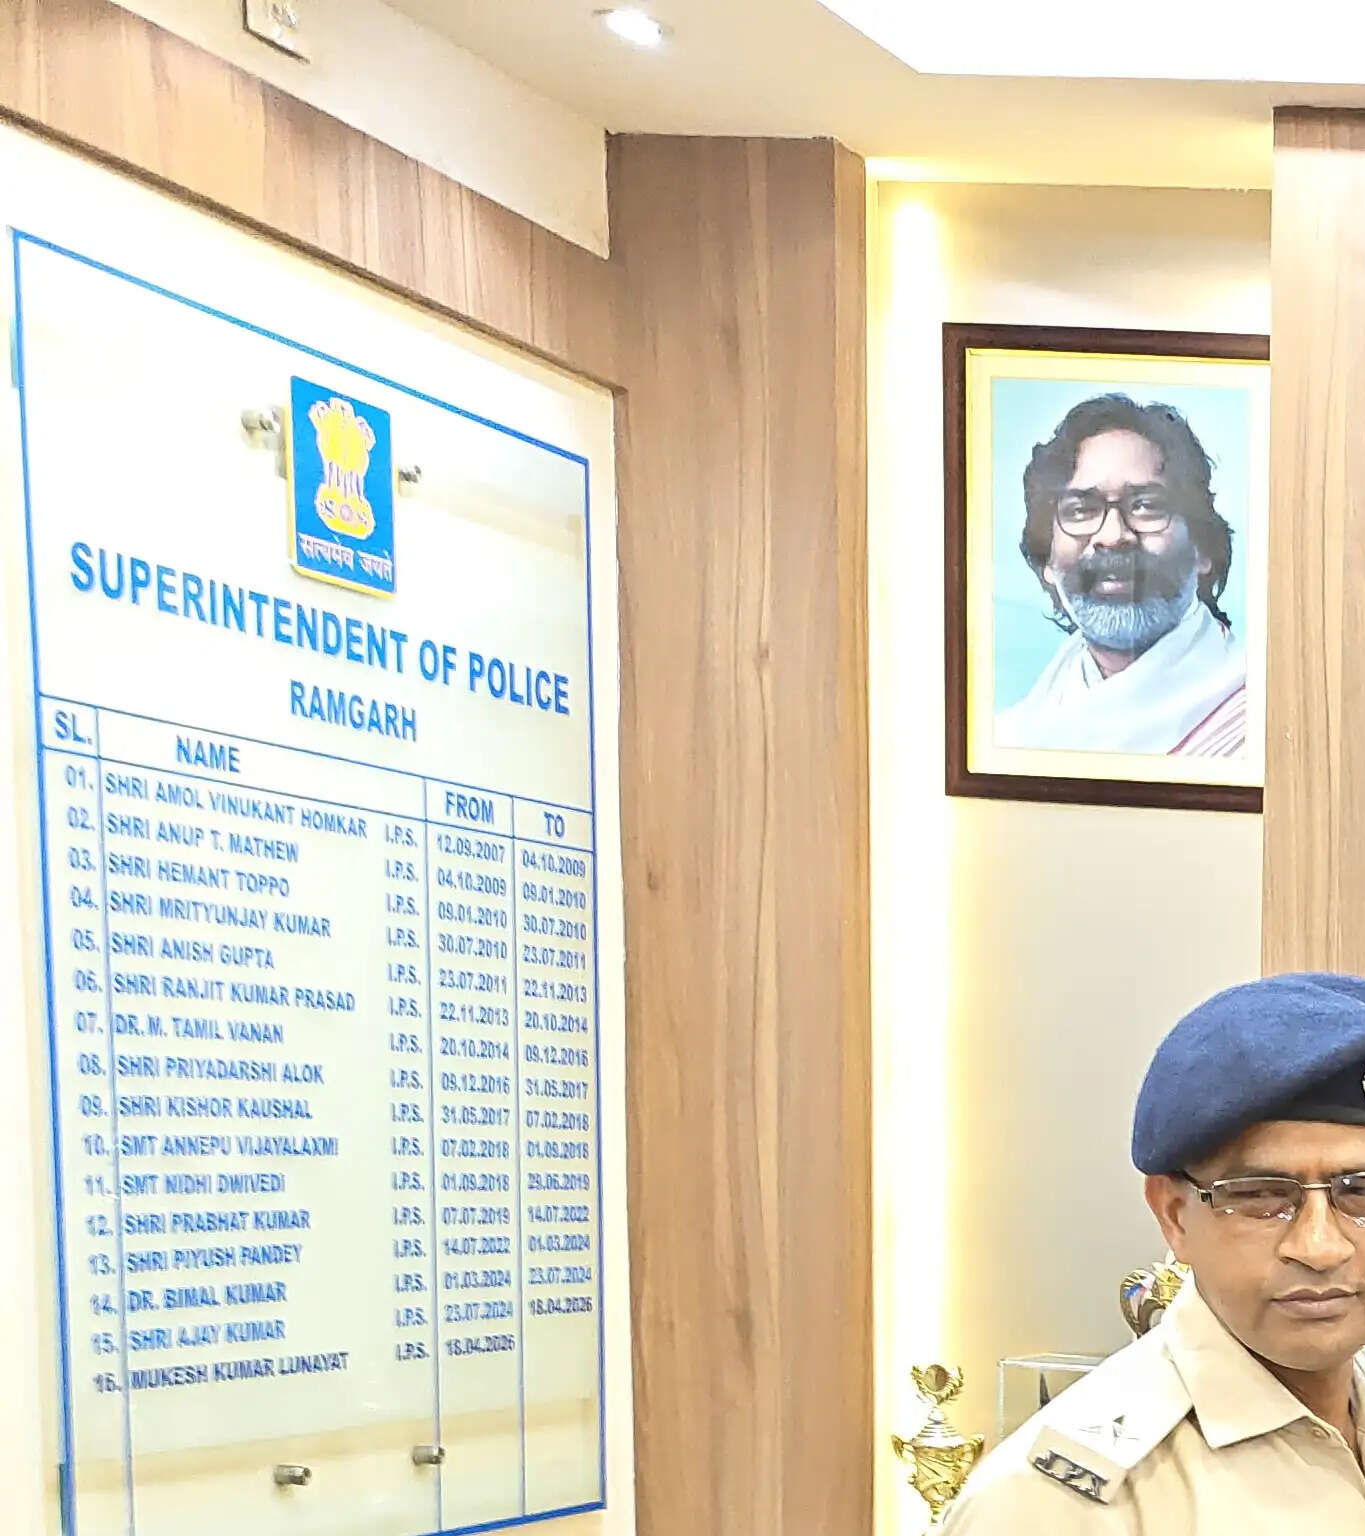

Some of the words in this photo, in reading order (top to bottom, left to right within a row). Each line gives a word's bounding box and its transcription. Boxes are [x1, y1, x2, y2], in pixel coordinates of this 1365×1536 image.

[69, 541, 408, 674] SUPERINTENDENT
[419, 640, 456, 684] OF
[469, 652, 570, 716] POLICE
[291, 678, 418, 742] RAMGARH
[54, 710, 92, 745] SL.
[175, 734, 240, 773] NAME
[445, 791, 494, 825] FROM
[544, 811, 565, 839] TO
[64, 765, 94, 790] 01.
[105, 772, 148, 800] SHRI
[155, 781, 203, 810] AMOL
[209, 790, 295, 825] VINUKANT
[301, 807, 367, 839] HOMKAR
[384, 824, 418, 848] I.P.S.
[437, 834, 505, 863] 12.09.2007
[523, 850, 585, 879] 04.10.2009
[67, 806, 95, 831] 02.
[106, 812, 149, 839] SHRI
[156, 821, 201, 848] ANUP
[229, 833, 298, 863] MATHEW
[385, 859, 419, 883] I.P.S.
[438, 868, 506, 897] 04.10.2009
[523, 882, 586, 911] 09.01.2010
[67, 847, 96, 871] 03.
[108, 851, 150, 880] SHRI
[157, 859, 229, 889] HEMANT
[236, 870, 290, 898] TOPPO
[386, 893, 420, 916] I.P.S.
[438, 902, 507, 929] 09.01.2010
[524, 914, 586, 941] 30.07.2010
[70, 886, 98, 911] 04.
[110, 891, 151, 916] SHRI
[160, 897, 268, 930] MRITYUNJAY
[274, 912, 331, 938] KUMAR
[387, 926, 420, 949] I.P.S.
[438, 933, 507, 959] 30.07.2010
[71, 928, 100, 952] 05.
[111, 931, 153, 958] SHRI
[160, 939, 213, 963] ANISH
[219, 945, 275, 969] GUPTA
[387, 963, 421, 986] I.P.S.
[439, 968, 507, 994] 23.07.2011
[524, 978, 587, 1004] 22.11.2013
[74, 969, 102, 993] 06.
[114, 972, 156, 997] SHRI
[164, 976, 224, 1001] RANJIT
[231, 982, 289, 1007] KUMAR
[294, 988, 355, 1011] PRASAD
[388, 996, 422, 1018] I.P.S.
[440, 1002, 509, 1027] 22.11.2013
[525, 1011, 588, 1034] 20.10.2014
[75, 1011, 103, 1033] 07.
[173, 1017, 224, 1040] TAMIL
[227, 1021, 283, 1043] VANAN
[389, 1032, 422, 1055] I.P.S.
[440, 1037, 510, 1060] 20.10.2014
[77, 1053, 106, 1076] 08.
[117, 1054, 160, 1078] SHRI
[166, 1055, 276, 1082] PRIYADARSHI
[282, 1063, 324, 1084] ALOK
[390, 1068, 423, 1090] I.P.S.
[79, 1094, 108, 1118] 09.
[119, 1095, 161, 1118] SHRI
[167, 1096, 232, 1118] KISHOR
[238, 1098, 313, 1120] KAUSHAL
[391, 1103, 424, 1124] I.P.S.
[82, 1134, 110, 1156] 10.
[120, 1134, 157, 1157] SMT
[162, 1135, 231, 1157] ANNEPU
[237, 1136, 339, 1157] VIJAYALAXMI
[391, 1136, 424, 1157] I.P.S.
[85, 1174, 114, 1196] 11.
[122, 1174, 158, 1195] SMT
[165, 1174, 211, 1195] NIDHI
[217, 1173, 284, 1195] DWIVEDI
[392, 1171, 425, 1192] I.P.S.
[124, 1212, 165, 1235] SHRI
[172, 1211, 249, 1233] PRABHAT
[253, 1210, 311, 1231] KUMAR
[392, 1206, 425, 1226] I.P.S.
[128, 1251, 169, 1273] SHRI
[174, 1247, 237, 1269] PIYUSH
[241, 1244, 302, 1266] PANDEY
[393, 1239, 426, 1258] I.P.S.
[164, 1286, 221, 1310] BIMAL
[225, 1281, 288, 1305] KUMAR
[394, 1274, 427, 1293] I.P.S.
[130, 1328, 172, 1351] SHRI
[177, 1325, 221, 1347] AJAY
[226, 1320, 285, 1343] KUMAR
[396, 1307, 428, 1327] I.P.S.
[132, 1364, 208, 1391] MUKESH
[213, 1358, 274, 1382] KUMAR
[278, 1352, 349, 1374] LUNAYAT
[396, 1342, 429, 1361] I.P.S.
